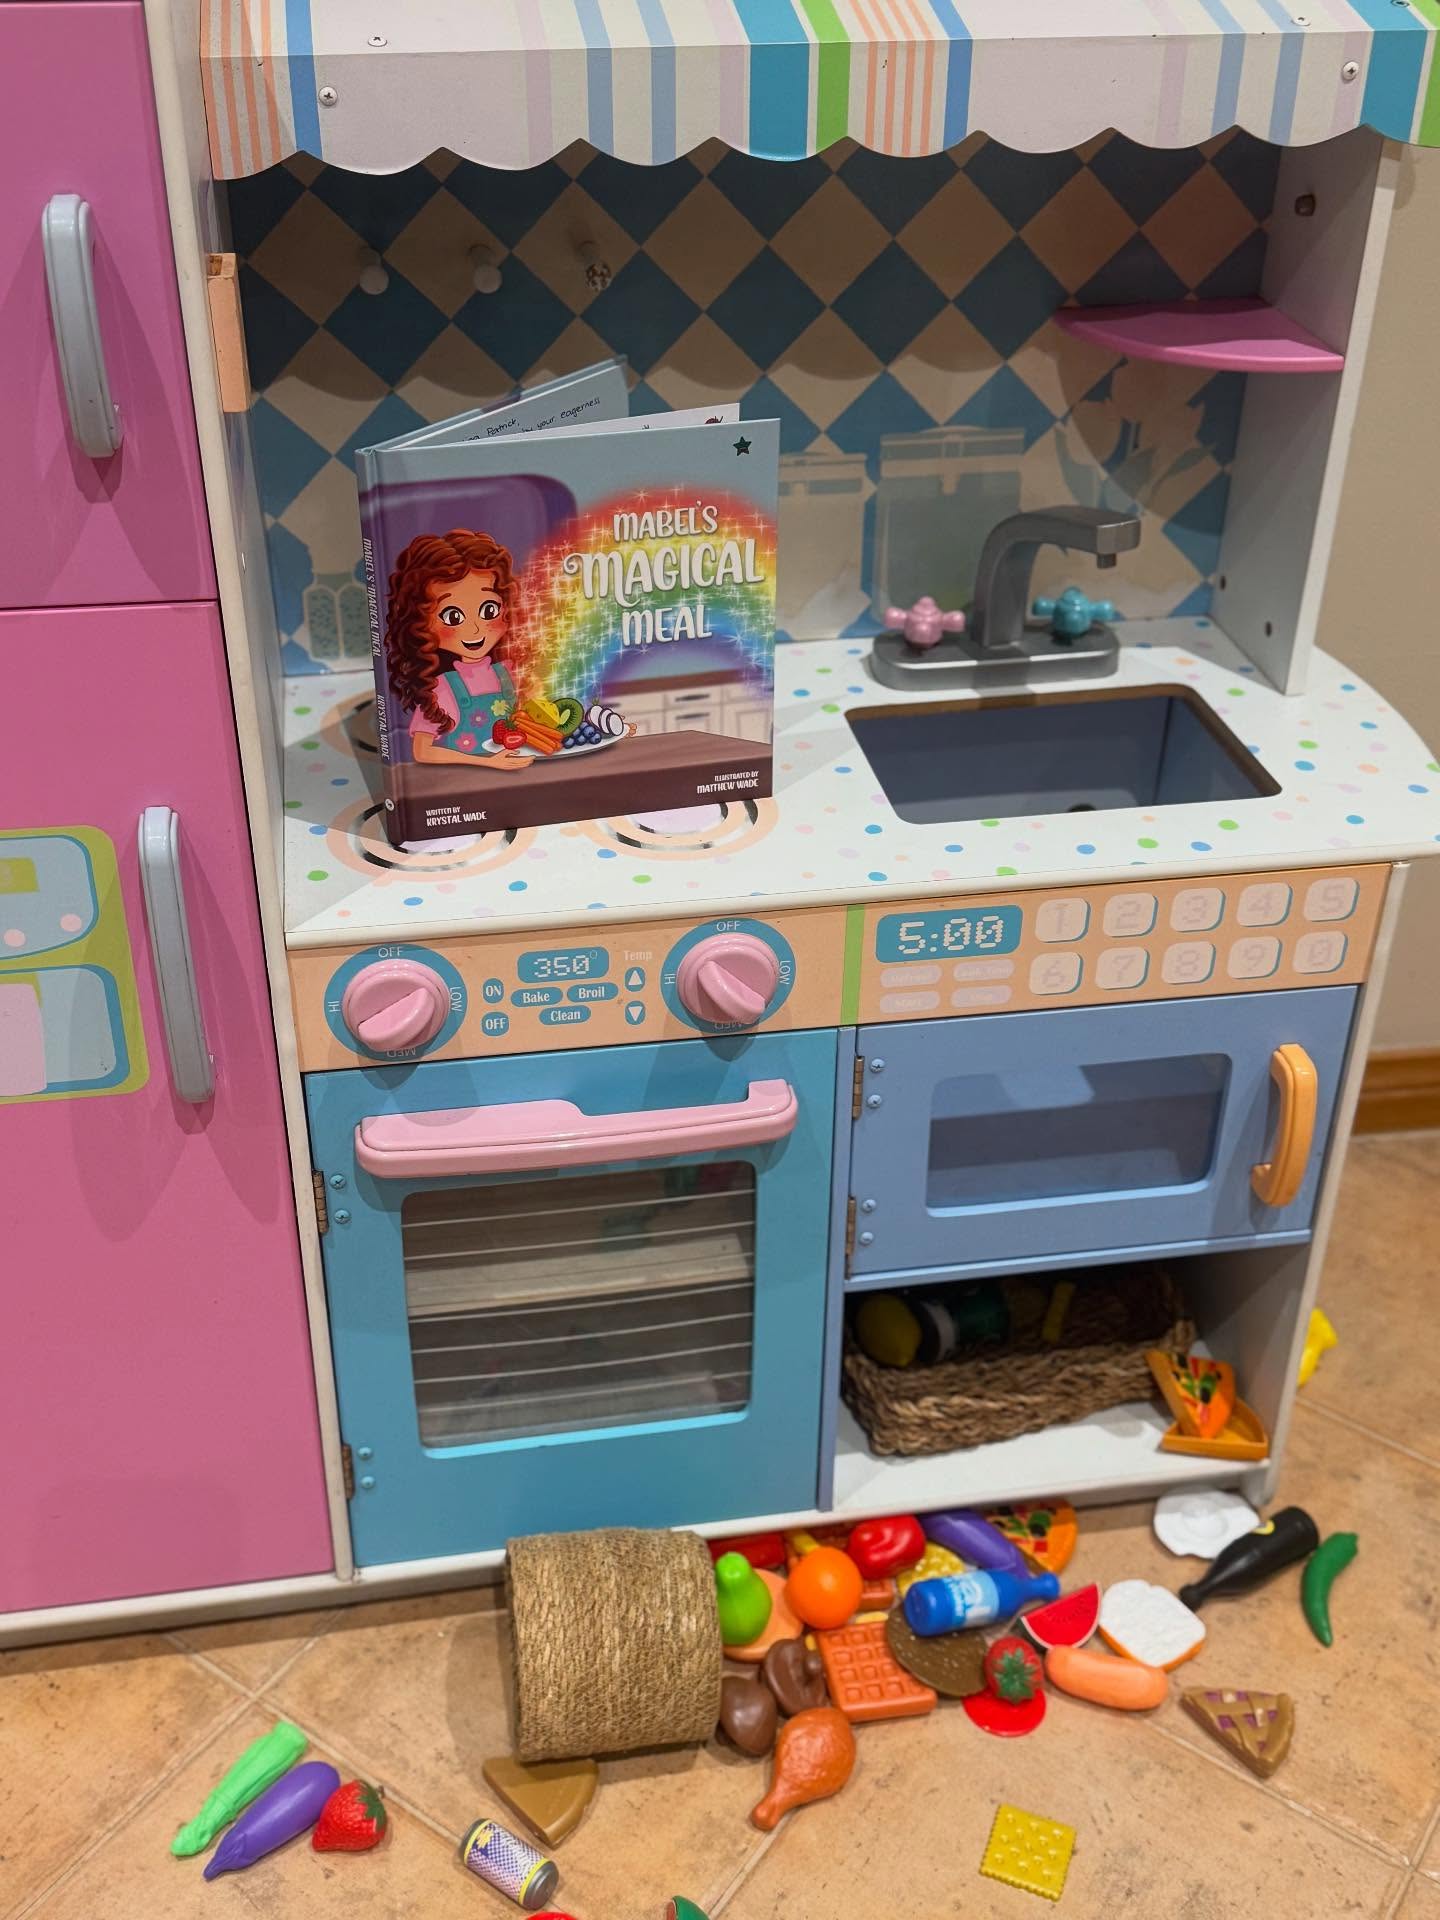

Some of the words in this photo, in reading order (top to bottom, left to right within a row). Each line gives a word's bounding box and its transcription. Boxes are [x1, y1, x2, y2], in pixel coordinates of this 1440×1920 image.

[613, 500, 718, 542] MABEL'S
[563, 538, 765, 608] MAGICAL
[367, 584, 379, 629] MAGICAL
[622, 604, 713, 647] MEAL
[371, 630, 381, 657] MEAL
[376, 694, 388, 732] KRYSTAL
[380, 733, 390, 760] WADE
[714, 771, 751, 782] ILLUSTRATED
[751, 770, 760, 778] BY
[696, 781, 735, 794] MATTHEW
[736, 778, 759, 789] WADE
[425, 807, 452, 817] WRITTEN
[452, 806, 461, 814] BY
[426, 815, 462, 827] KRYSTAL
[463, 811, 488, 822] WADE
[1318, 884, 1346, 914] 5
[716, 920, 741, 932] OFF
[898, 915, 1004, 954] 5:00
[378, 946, 404, 958] OFF
[623, 950, 653, 962] Temp
[664, 973, 676, 985] HI
[778, 960, 792, 985] LOW
[449, 986, 462, 1012] LOW
[485, 985, 502, 997] ON
[522, 991, 550, 1004] Bake
[578, 986, 605, 999] Broil
[327, 1000, 340, 1013] HI
[485, 1017, 507, 1030] OFF
[550, 1009, 581, 1022] Clean
